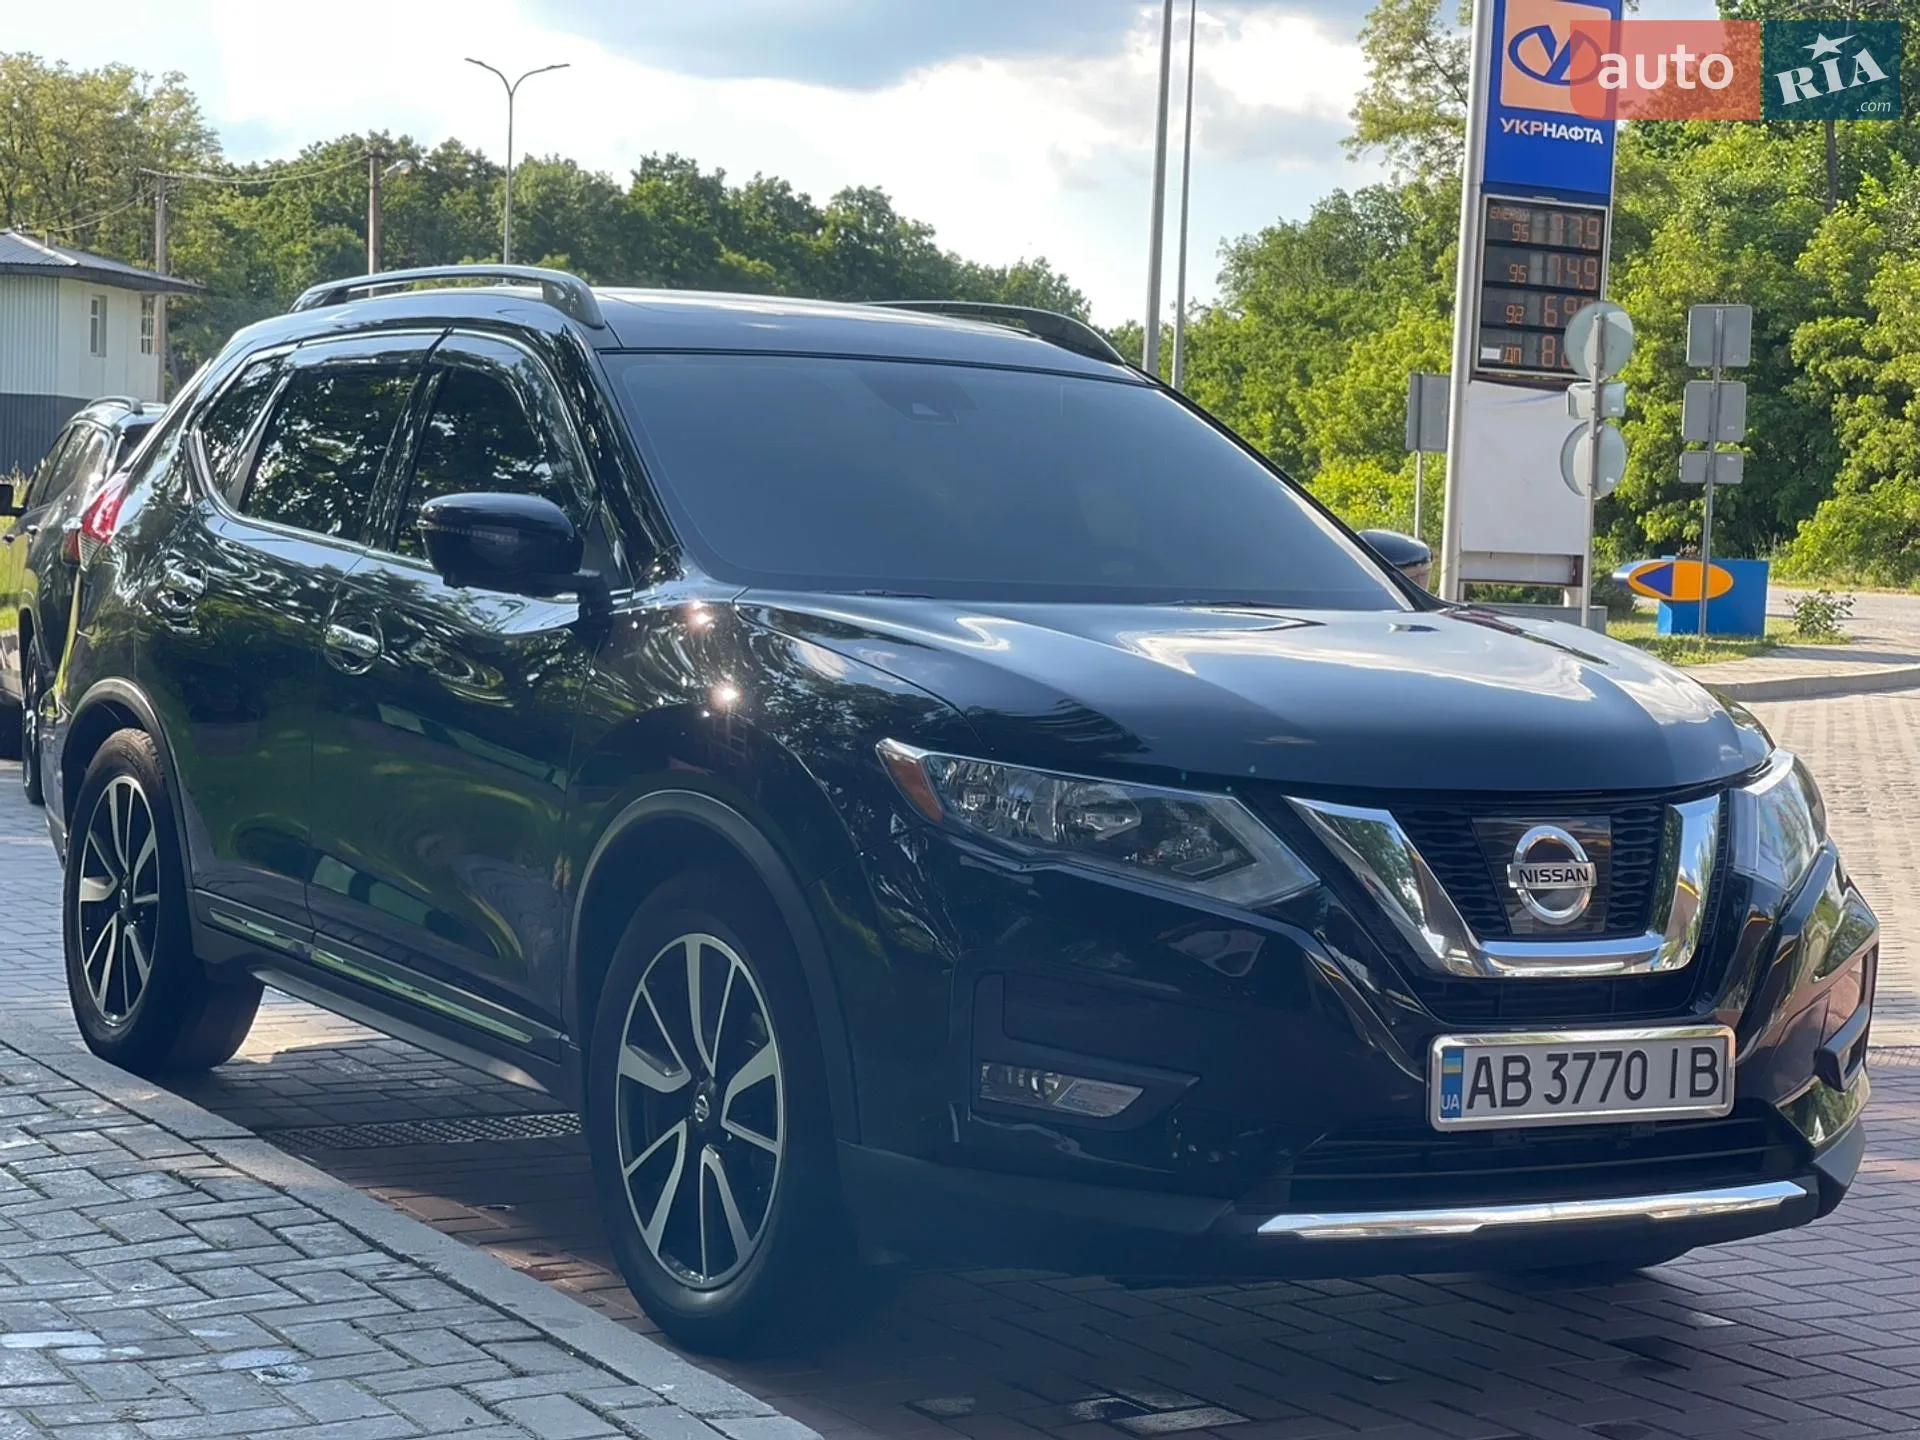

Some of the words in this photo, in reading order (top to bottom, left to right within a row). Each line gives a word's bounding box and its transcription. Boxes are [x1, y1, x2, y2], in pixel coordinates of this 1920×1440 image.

[1500, 117, 1603, 144] УКРНАФТА
[1519, 867, 1589, 883] NISSAN
[1466, 1054, 1532, 1110] AB
[1543, 1049, 1648, 1105] 3770
[1669, 1046, 1720, 1099] IB
[1441, 1094, 1460, 1111] UA
